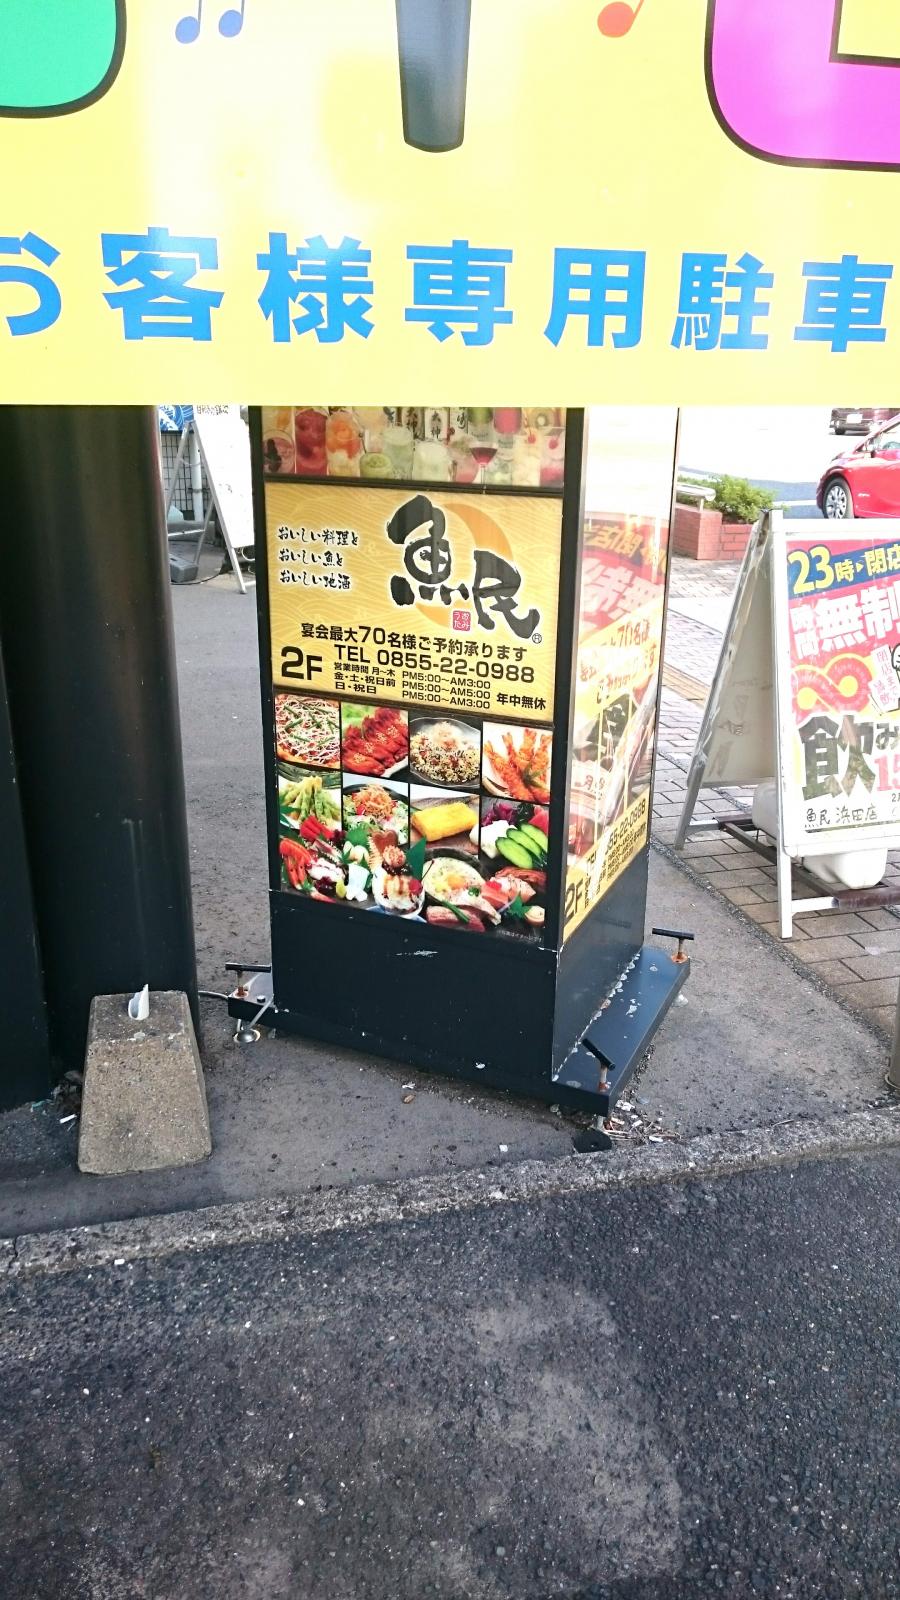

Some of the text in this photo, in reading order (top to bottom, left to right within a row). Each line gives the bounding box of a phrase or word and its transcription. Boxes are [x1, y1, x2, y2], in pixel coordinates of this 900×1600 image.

[278, 526, 359, 546] おいしい料理と
[279, 548, 344, 567] おいしい魚と
[387, 494, 540, 640] 魚民
[787, 544, 855, 594] 23時
[280, 570, 351, 590] おいしい地酒
[301, 623, 528, 662] 宴会最大70名様ご予約承ります
[281, 646, 323, 681] 2F
[334, 643, 535, 684] TEL 0855-22-0988
[334, 662, 369, 674] 営業時間
[496, 692, 547, 711] 年中無休
[804, 808, 831, 828] 魚民
